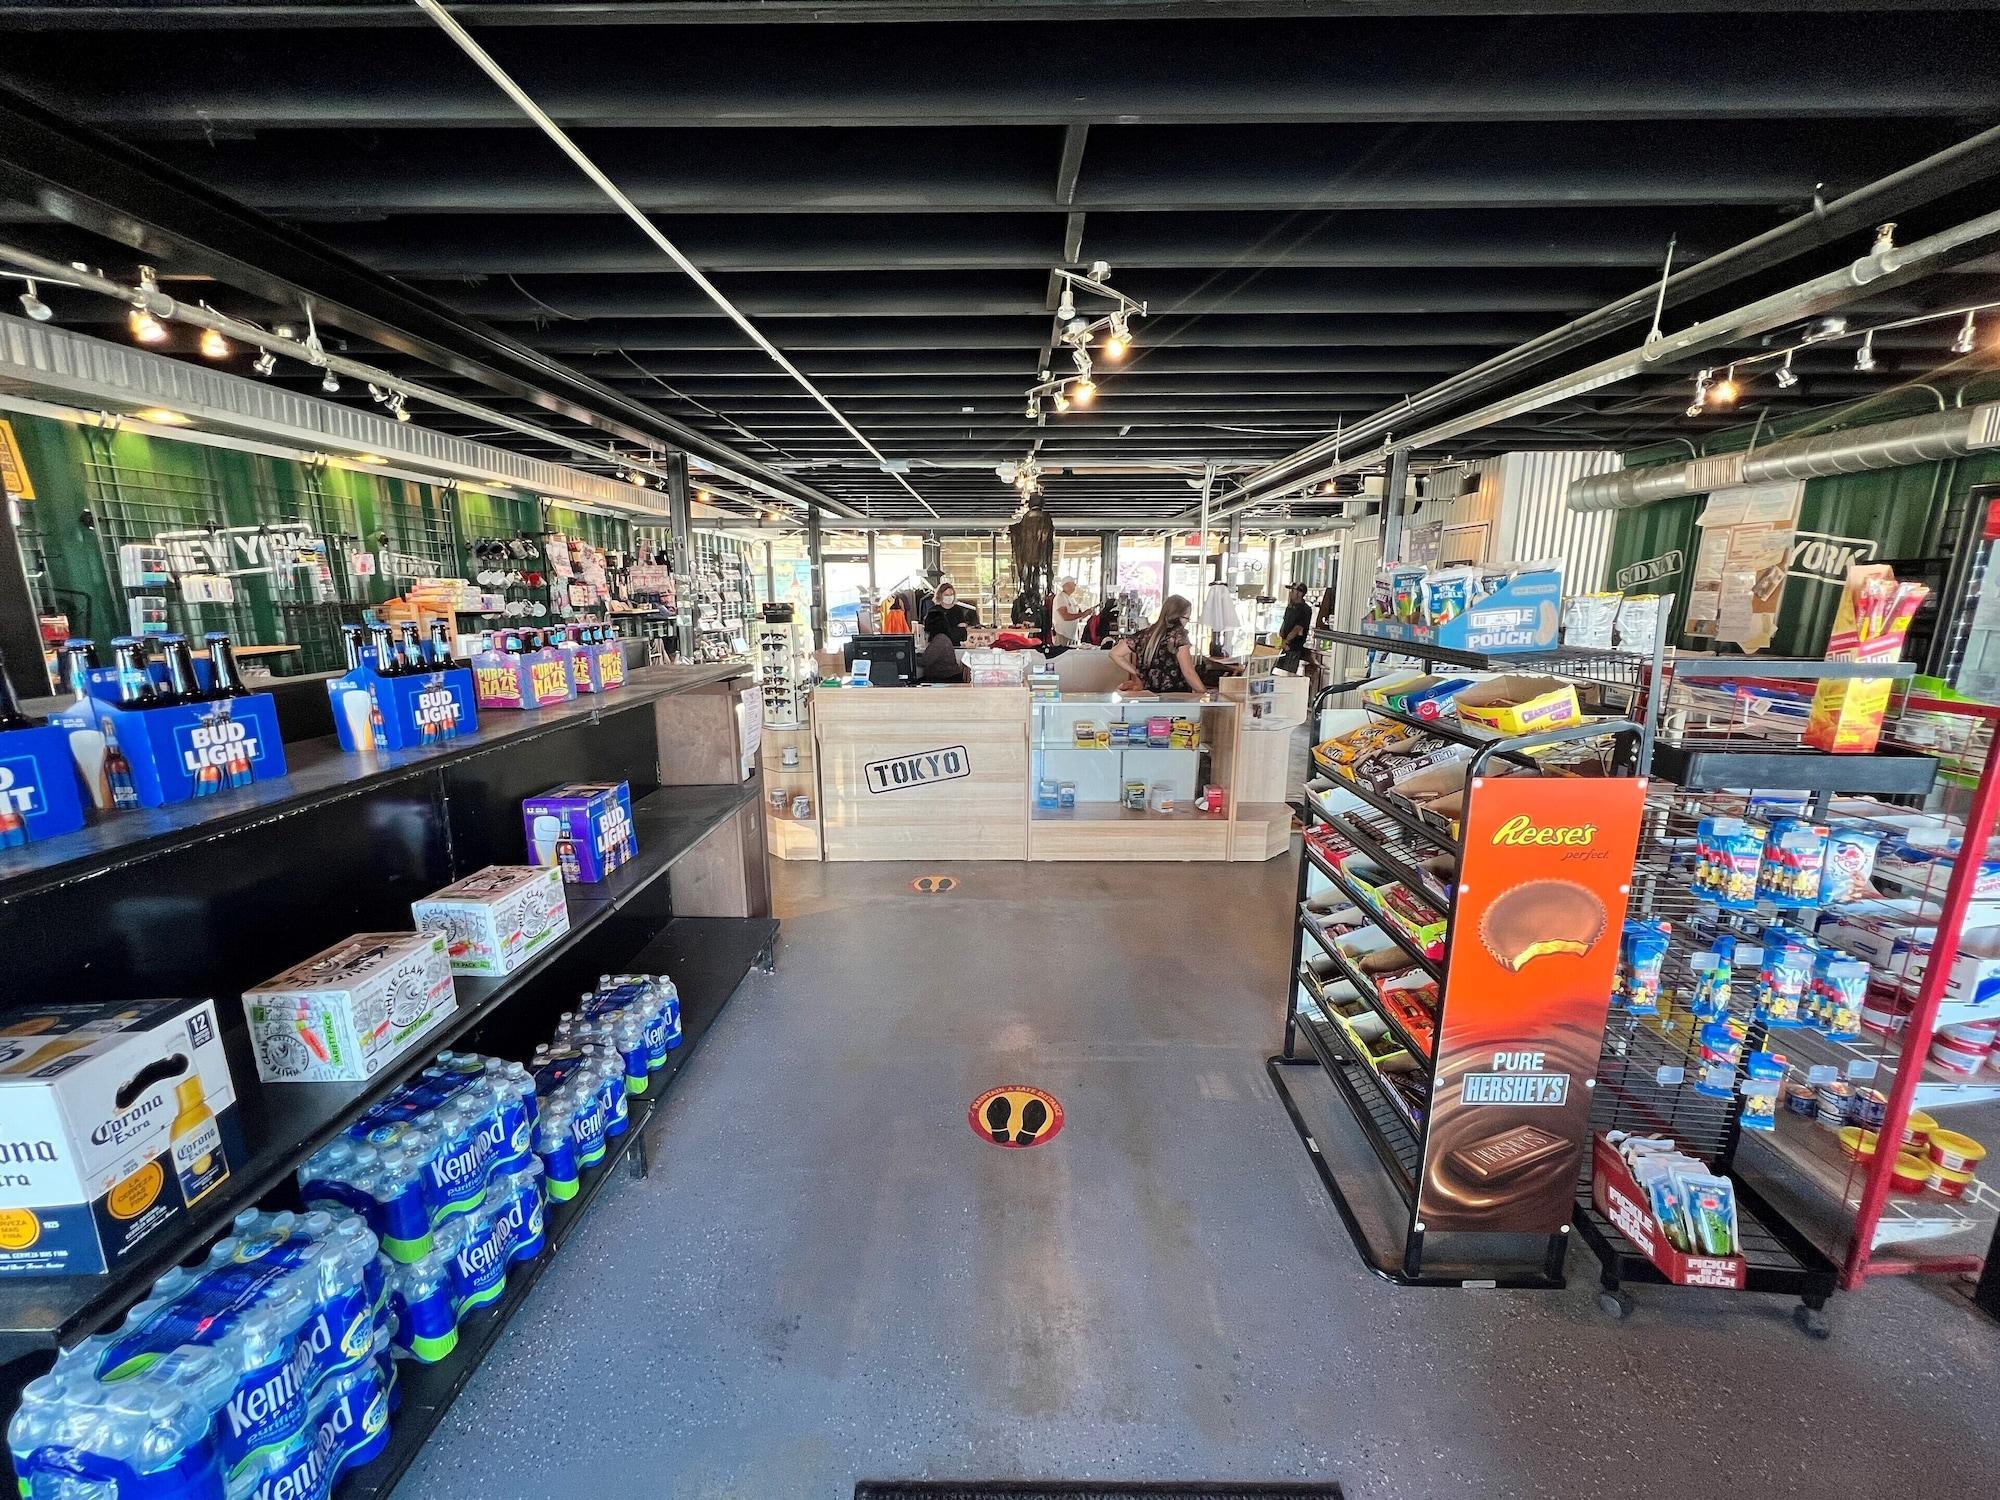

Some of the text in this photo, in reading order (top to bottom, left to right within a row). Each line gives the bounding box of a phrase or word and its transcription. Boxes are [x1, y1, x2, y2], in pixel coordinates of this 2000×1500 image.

[1468, 631, 1533, 650] POUCH
[477, 668, 516, 681] PURPLE
[531, 660, 565, 680] PURPLE
[479, 674, 519, 698] HAZE
[533, 671, 569, 698] HAZE
[419, 690, 453, 709] BUD
[415, 703, 460, 726] LIGHT
[191, 723, 246, 749] BUD
[184, 738, 260, 771] LIGHT
[873, 750, 962, 787] TOKYO
[599, 806, 625, 833] BUD
[1491, 814, 1598, 846] Reese's
[597, 818, 631, 853] LIGHT
[384, 965, 425, 1017] WHITE CLAW
[190, 1014, 207, 1034] 12
[325, 1014, 340, 1063] VARIETY PACK
[260, 1040, 301, 1077] WHITE CLAW
[1493, 1052, 1546, 1071] PURE
[1466, 1076, 1564, 1103] HERSHEY'S
[90, 1094, 165, 1146] Corona
[114, 1120, 151, 1146] Extra
[177, 1127, 216, 1161] Corona
[1608, 1185, 1653, 1234] PICKLE
[1608, 1207, 1655, 1257] POUCH
[1688, 1258, 1737, 1271] PICKLE
[1686, 1274, 1736, 1288] POUCH
